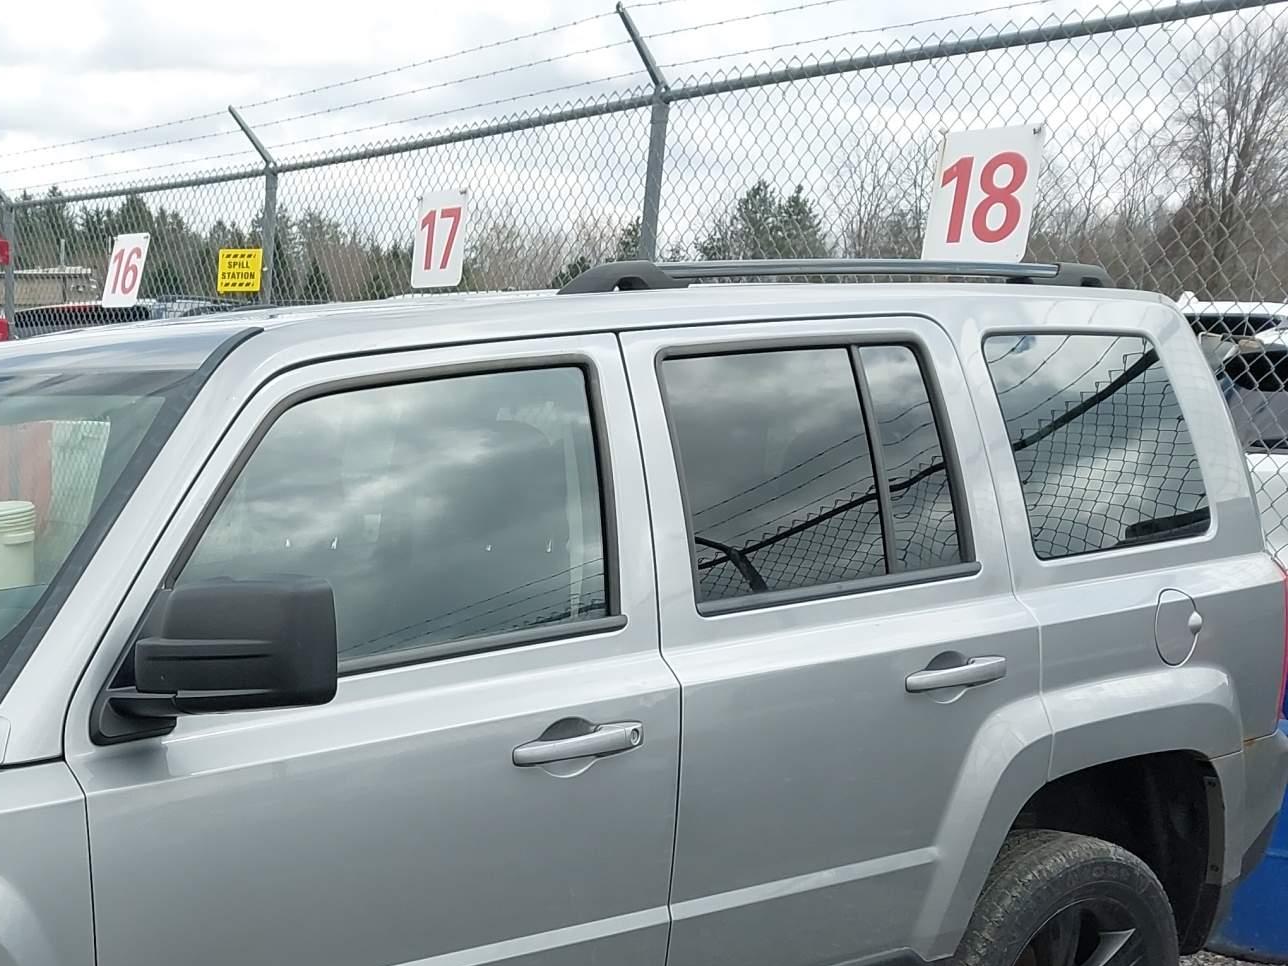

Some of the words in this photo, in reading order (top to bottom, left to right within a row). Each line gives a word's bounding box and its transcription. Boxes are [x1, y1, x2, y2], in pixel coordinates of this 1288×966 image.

[941, 151, 1028, 244] 18
[420, 206, 462, 271] 17
[112, 246, 142, 296] 16
[221, 271, 255, 280] STATION
[227, 260, 250, 269] SPILL
